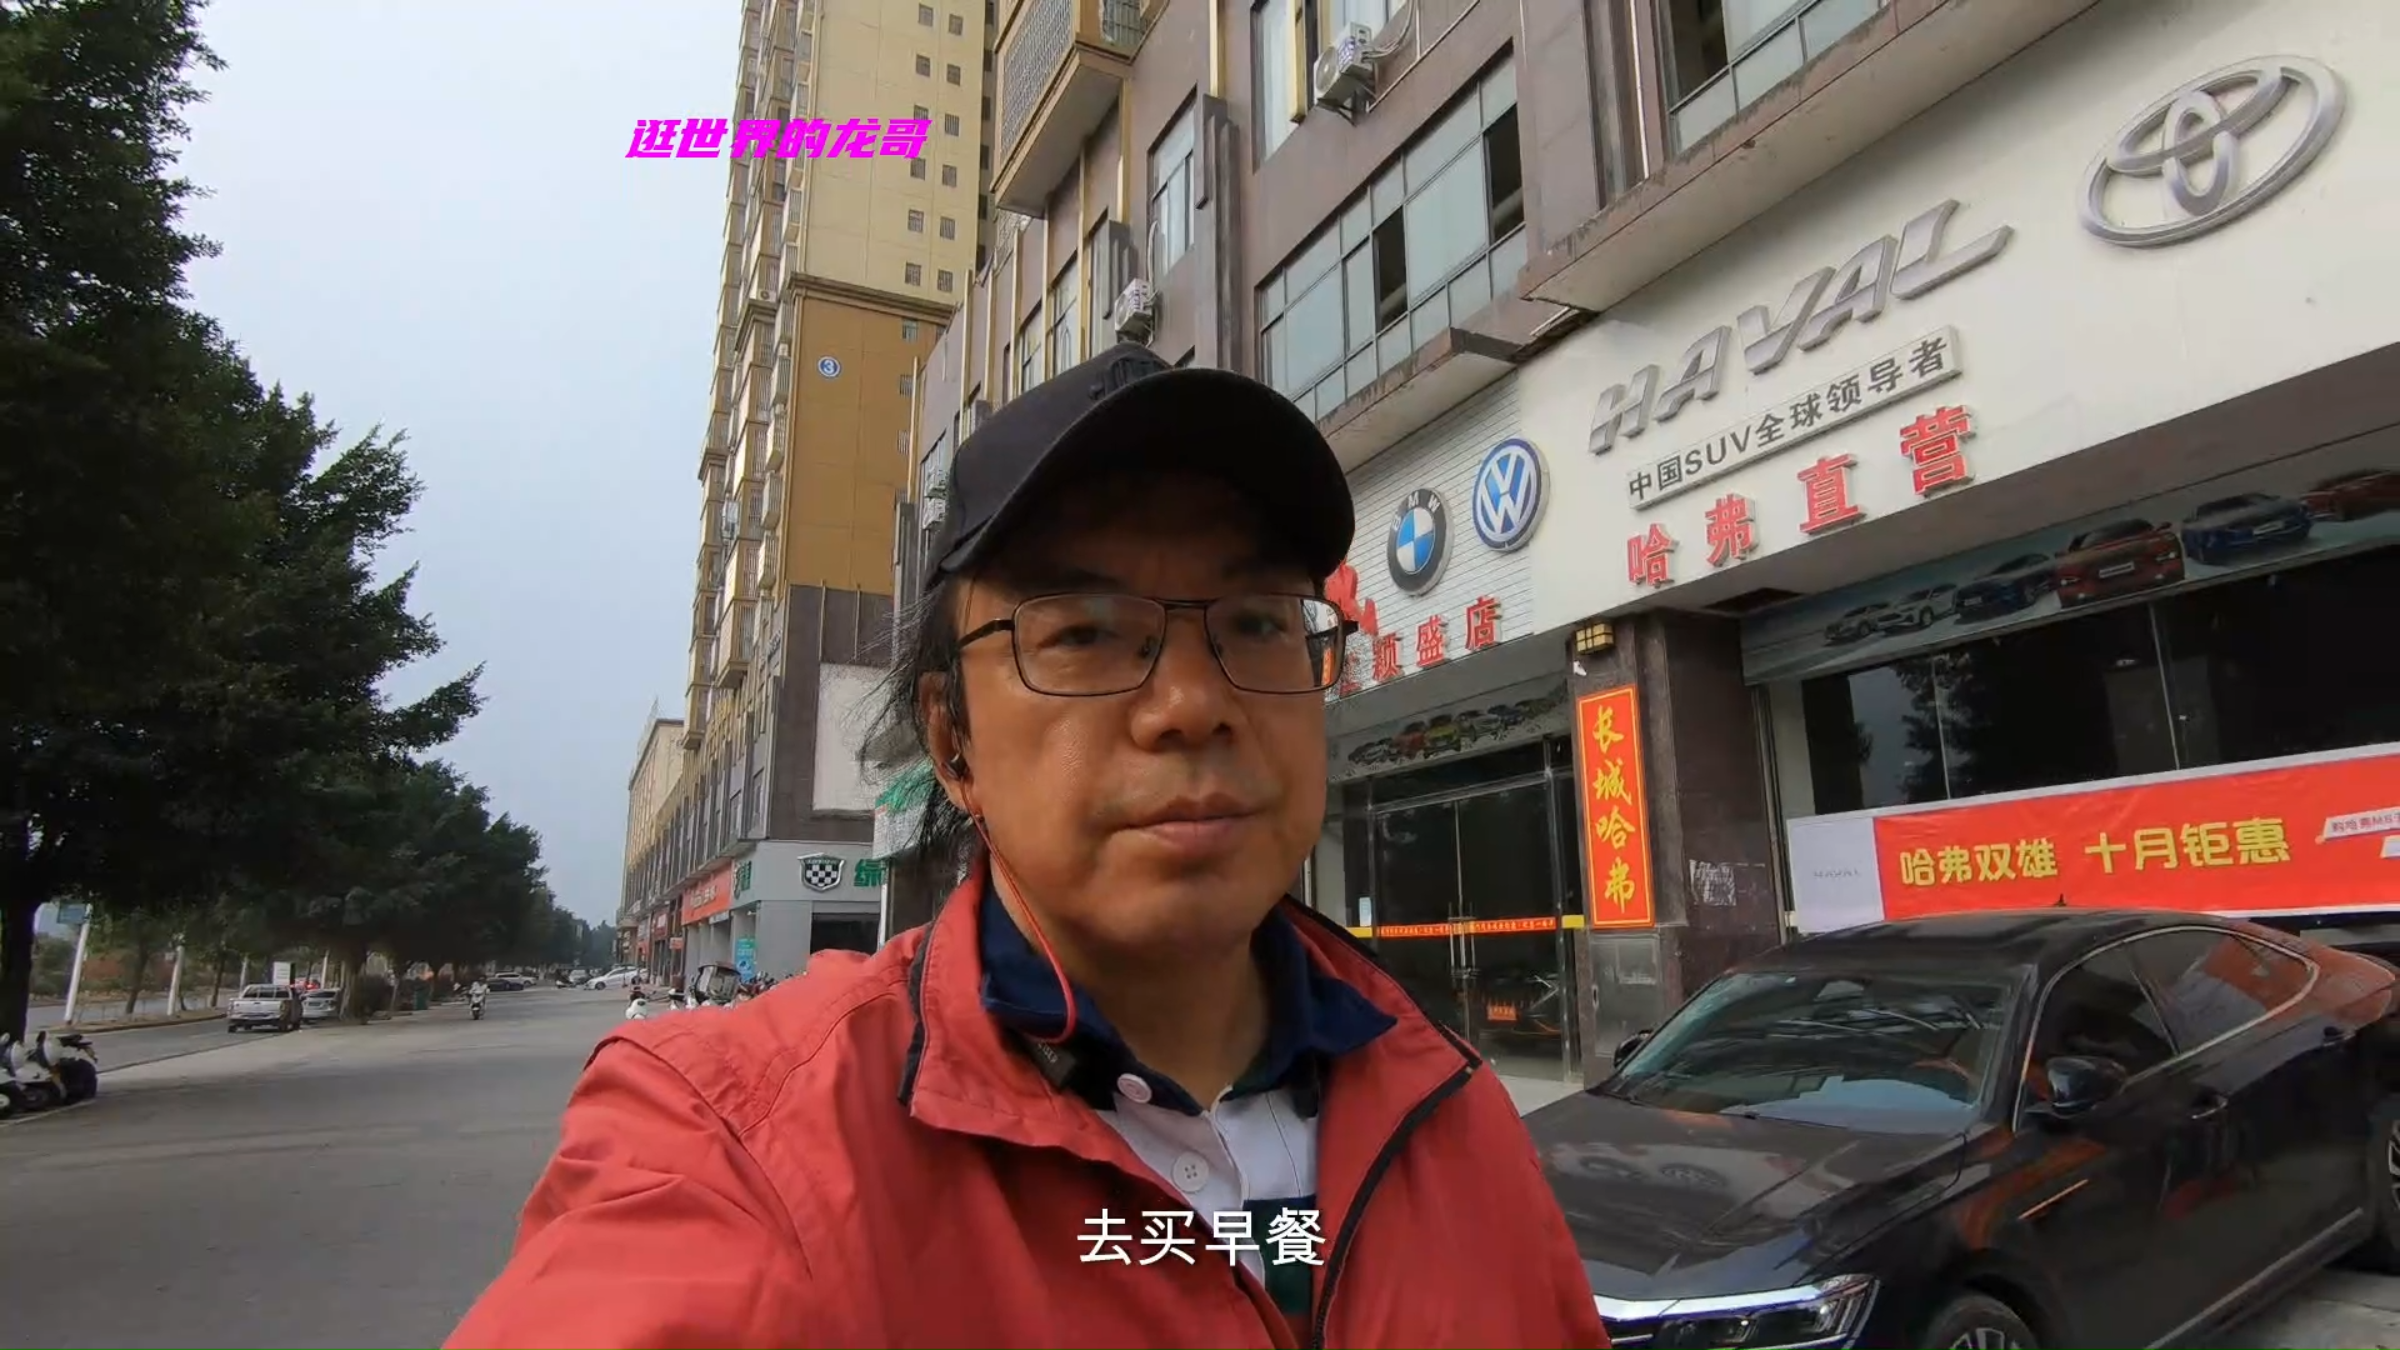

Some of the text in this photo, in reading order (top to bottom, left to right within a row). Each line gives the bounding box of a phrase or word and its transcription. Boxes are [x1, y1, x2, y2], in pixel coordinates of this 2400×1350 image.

[1588, 198, 2014, 455] HAVAL
[1627, 404, 1977, 588] 哈弗直营
[1628, 335, 1948, 501] 中国SUV全球领导者
[1391, 490, 1442, 532] BMW
[1592, 704, 1637, 915] 长城哈弗
[1900, 817, 2292, 888] 哈弗双雄 十月钜惠
